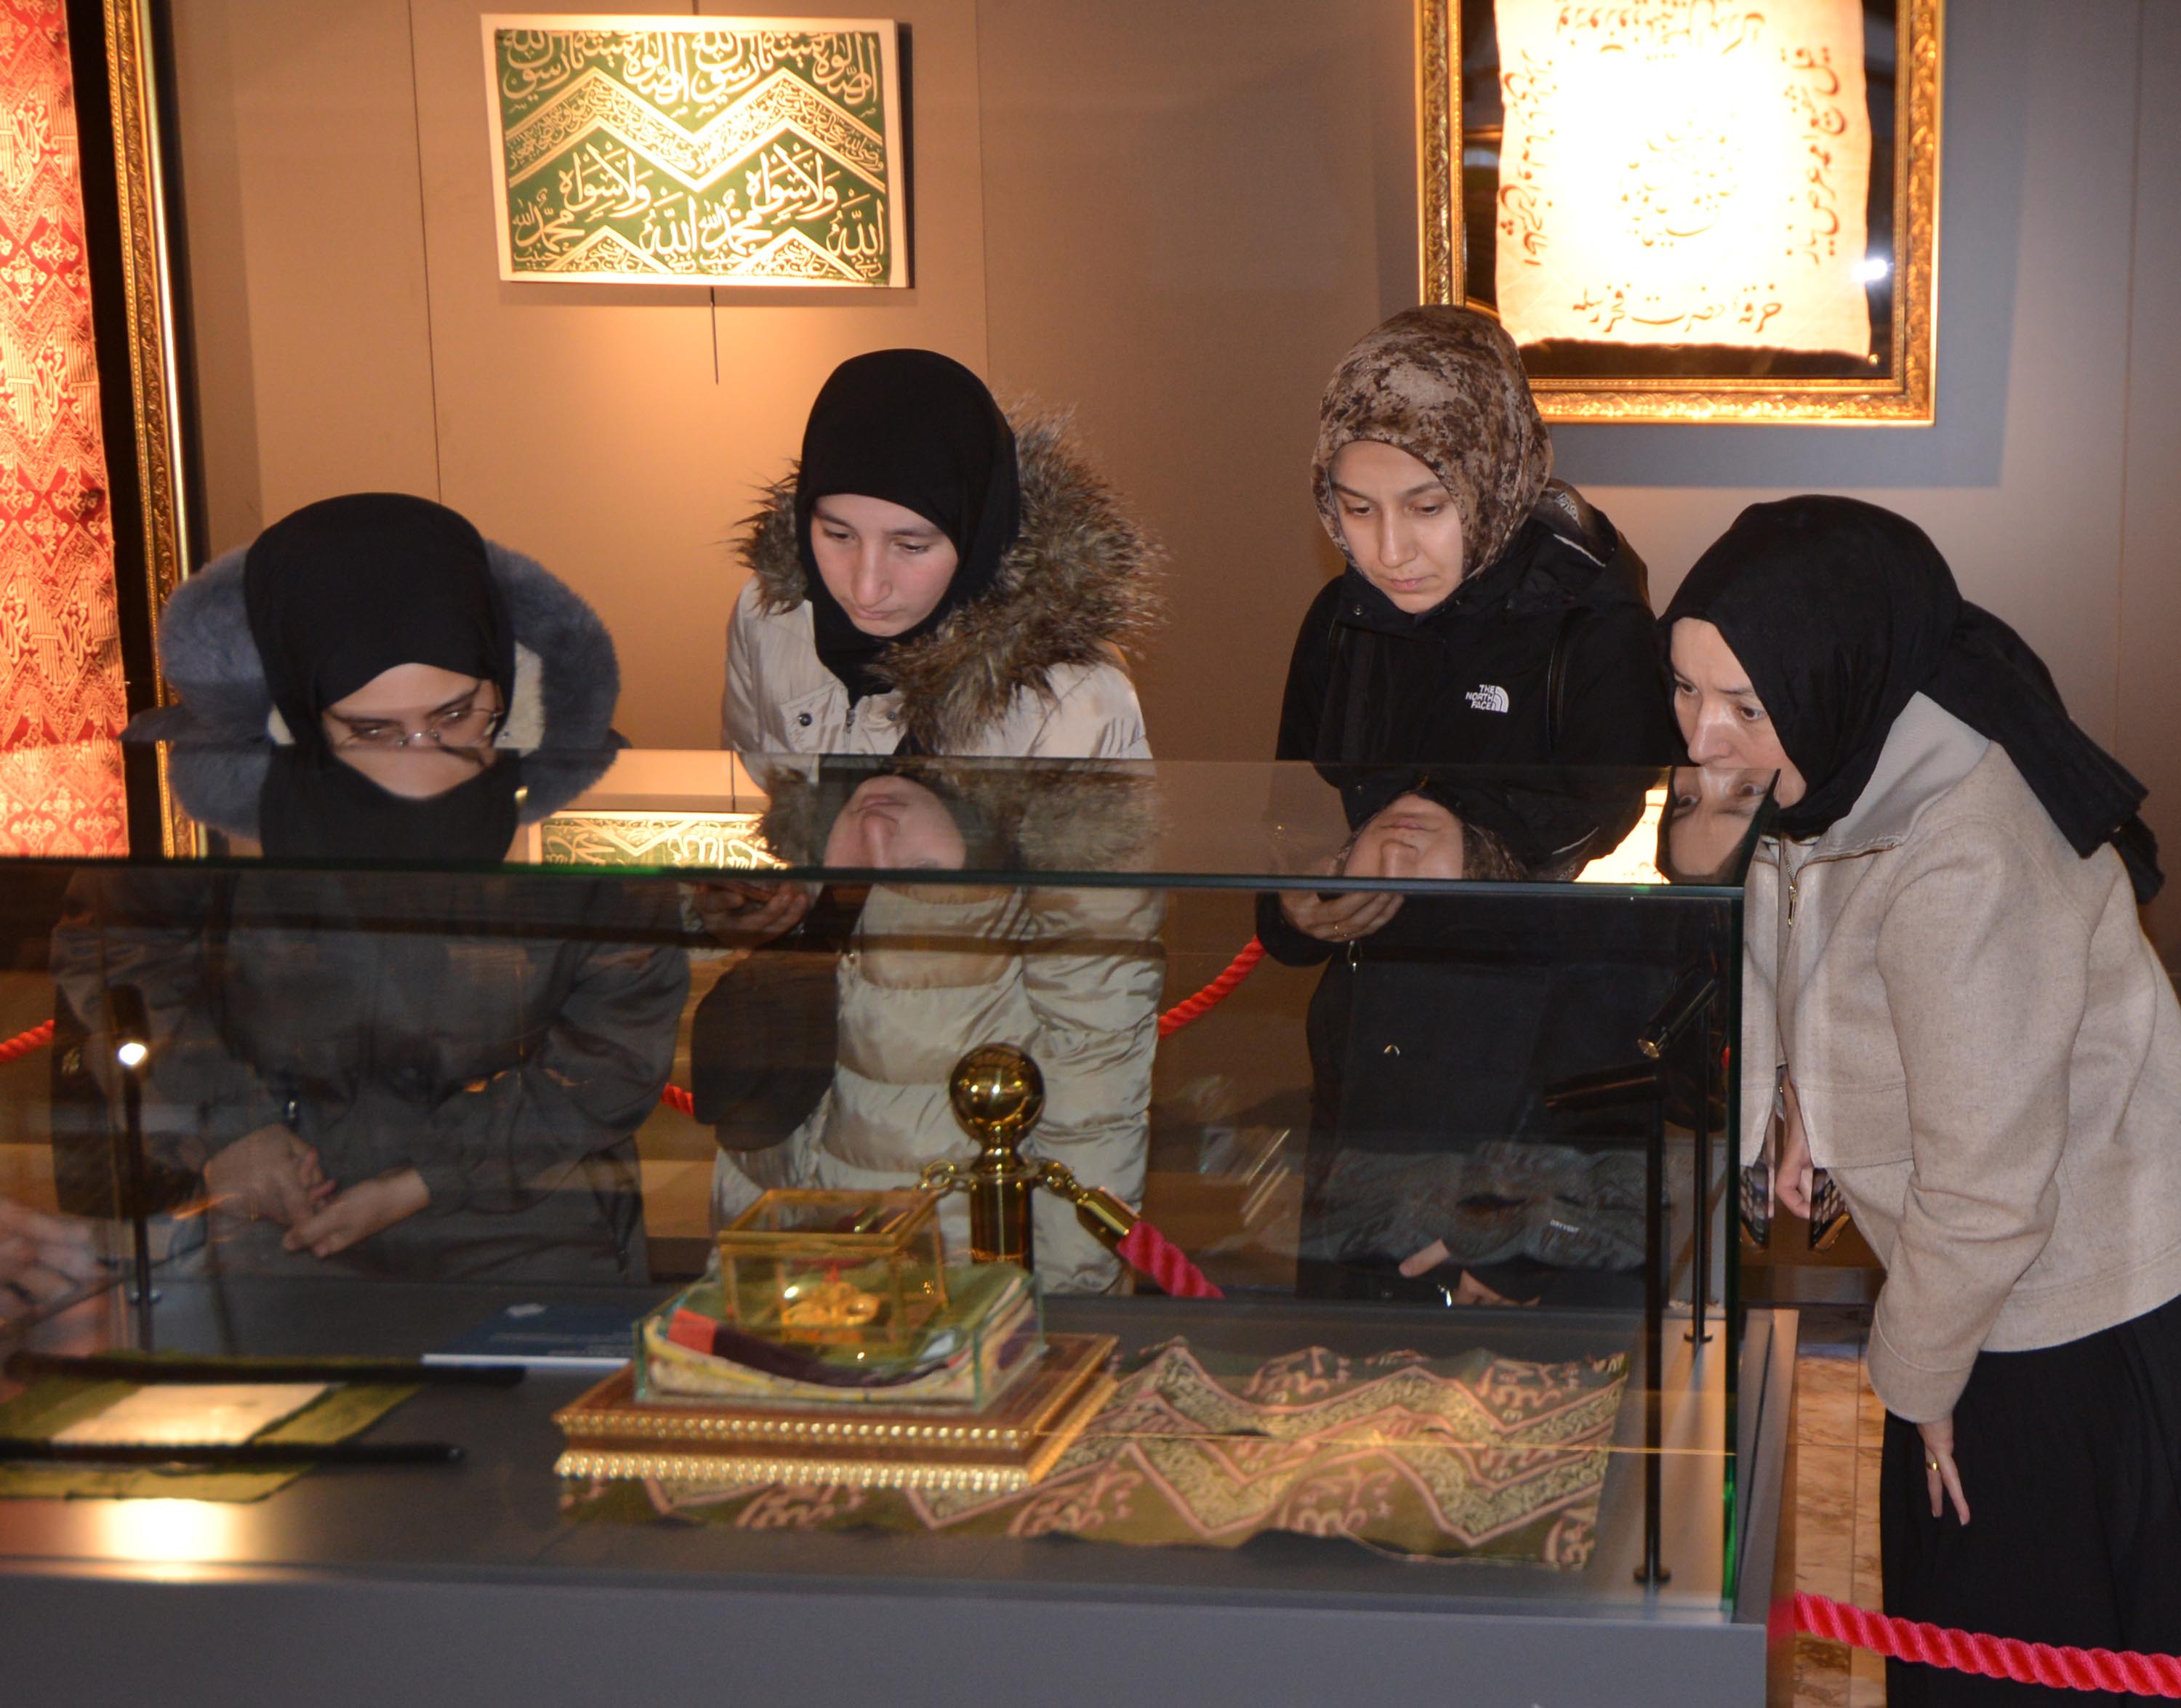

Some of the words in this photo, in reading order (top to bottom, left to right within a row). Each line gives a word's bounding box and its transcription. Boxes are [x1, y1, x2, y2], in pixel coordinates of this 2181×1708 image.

[1479, 684, 1495, 693] THE
[1465, 692, 1494, 702] NORTH
[1471, 701, 1491, 710] FACE
